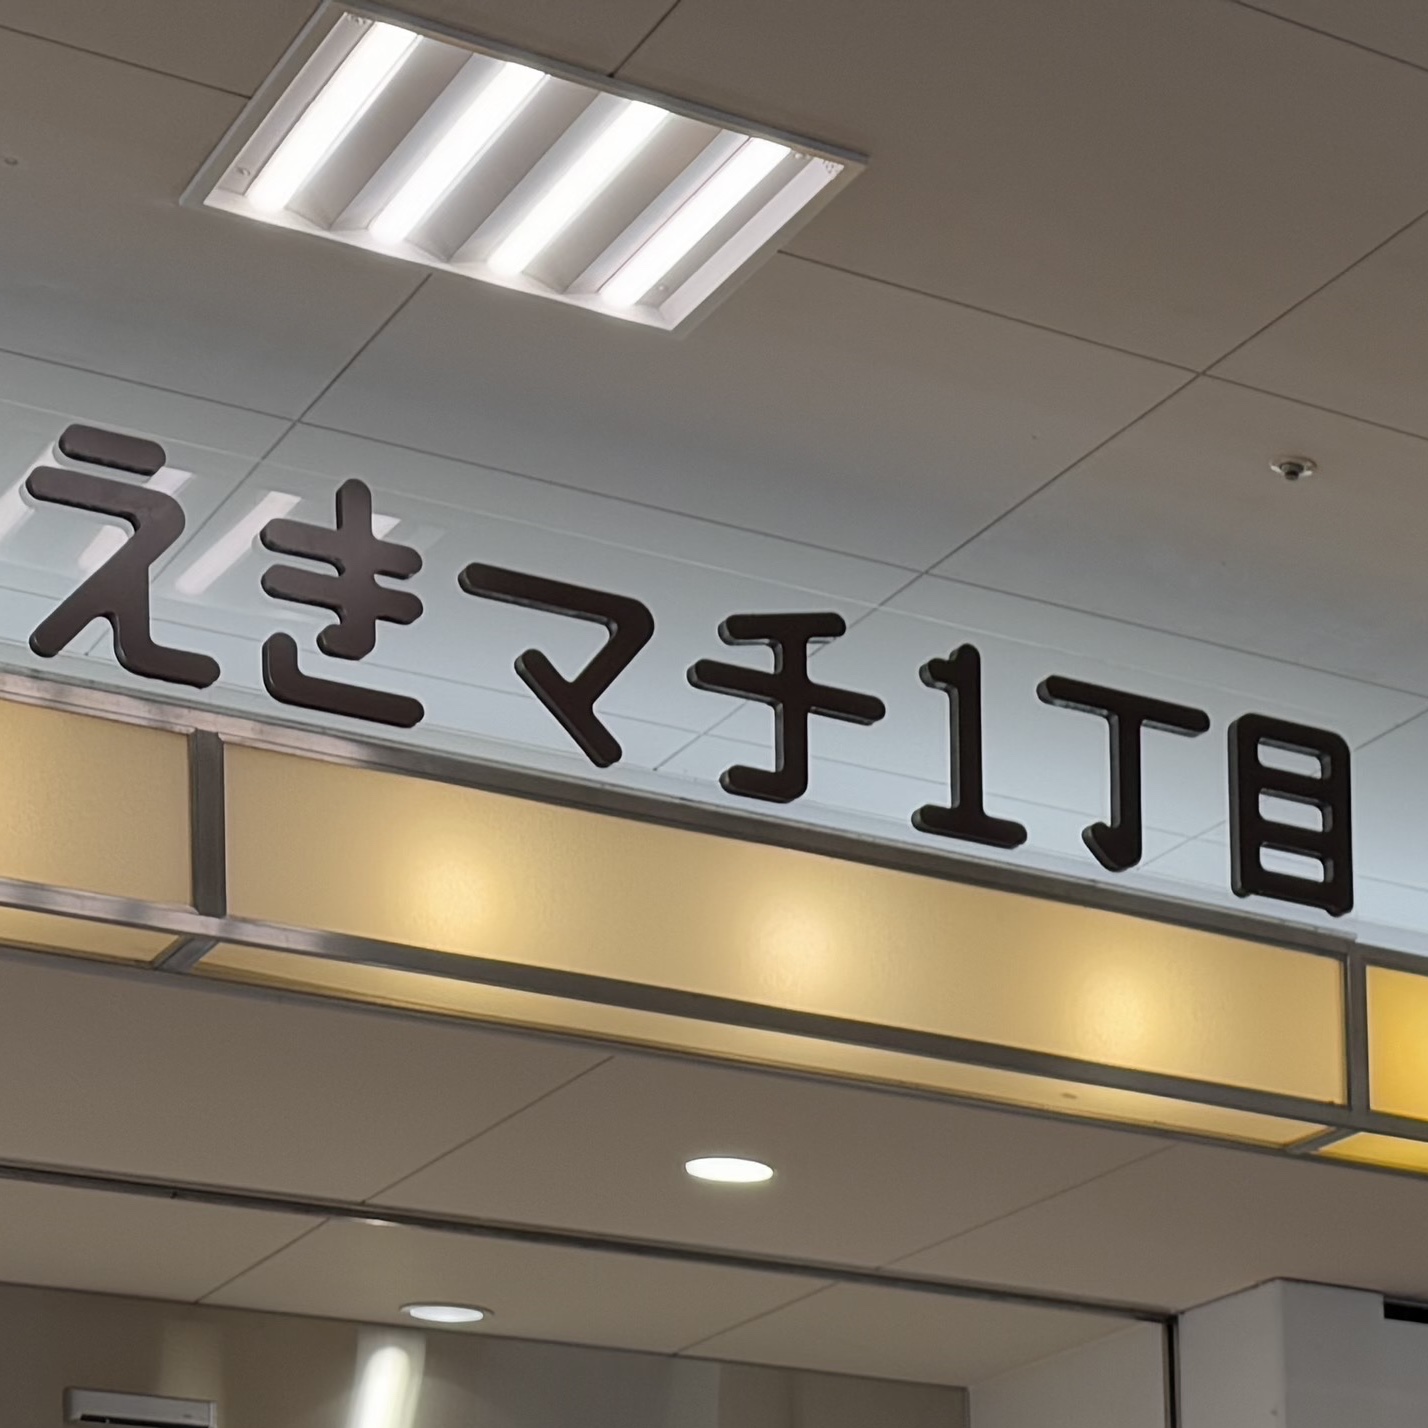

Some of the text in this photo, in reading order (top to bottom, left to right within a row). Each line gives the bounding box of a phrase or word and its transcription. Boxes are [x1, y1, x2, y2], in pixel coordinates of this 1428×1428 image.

[25, 424, 1354, 915] えきマチ1丁目
